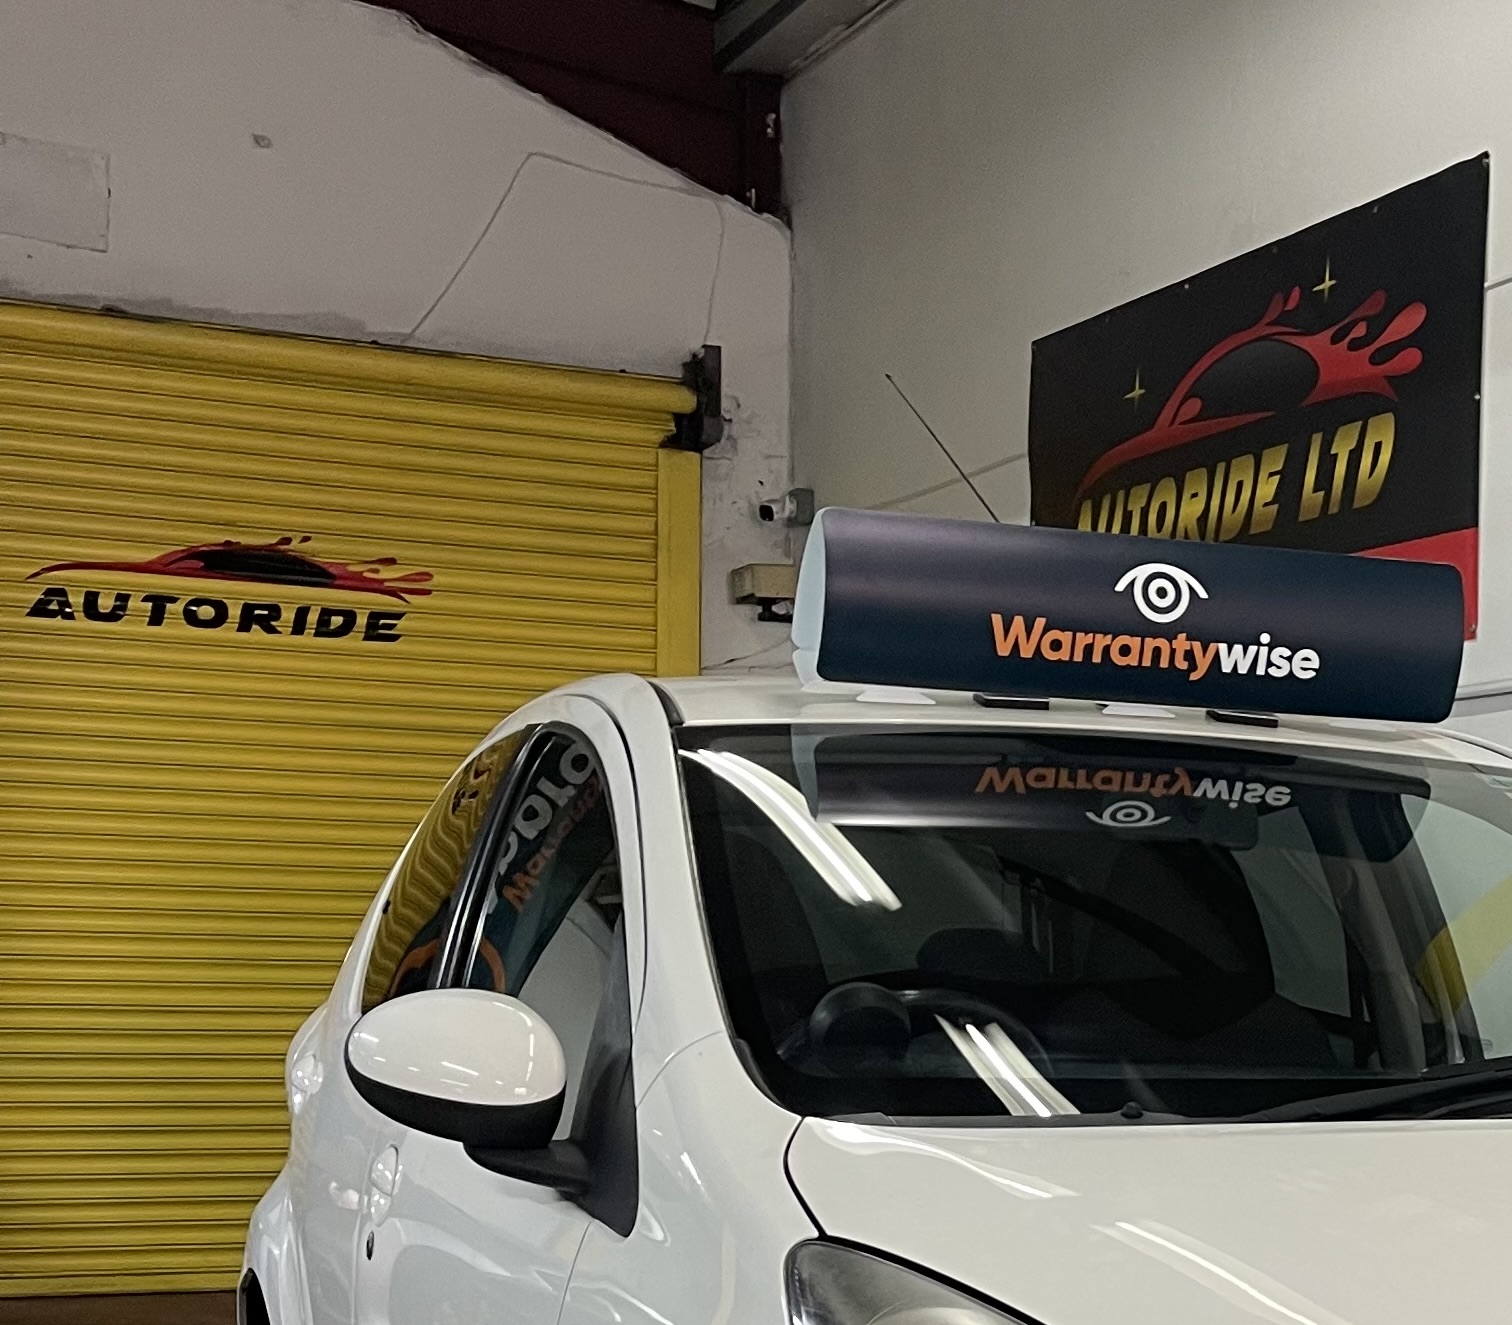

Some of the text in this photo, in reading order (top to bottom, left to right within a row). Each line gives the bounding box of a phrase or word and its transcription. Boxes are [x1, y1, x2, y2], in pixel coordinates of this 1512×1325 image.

[1299, 412, 1396, 522] LTD
[25, 587, 407, 642] AUTORIDE
[991, 613, 1320, 680] Warrantywise
